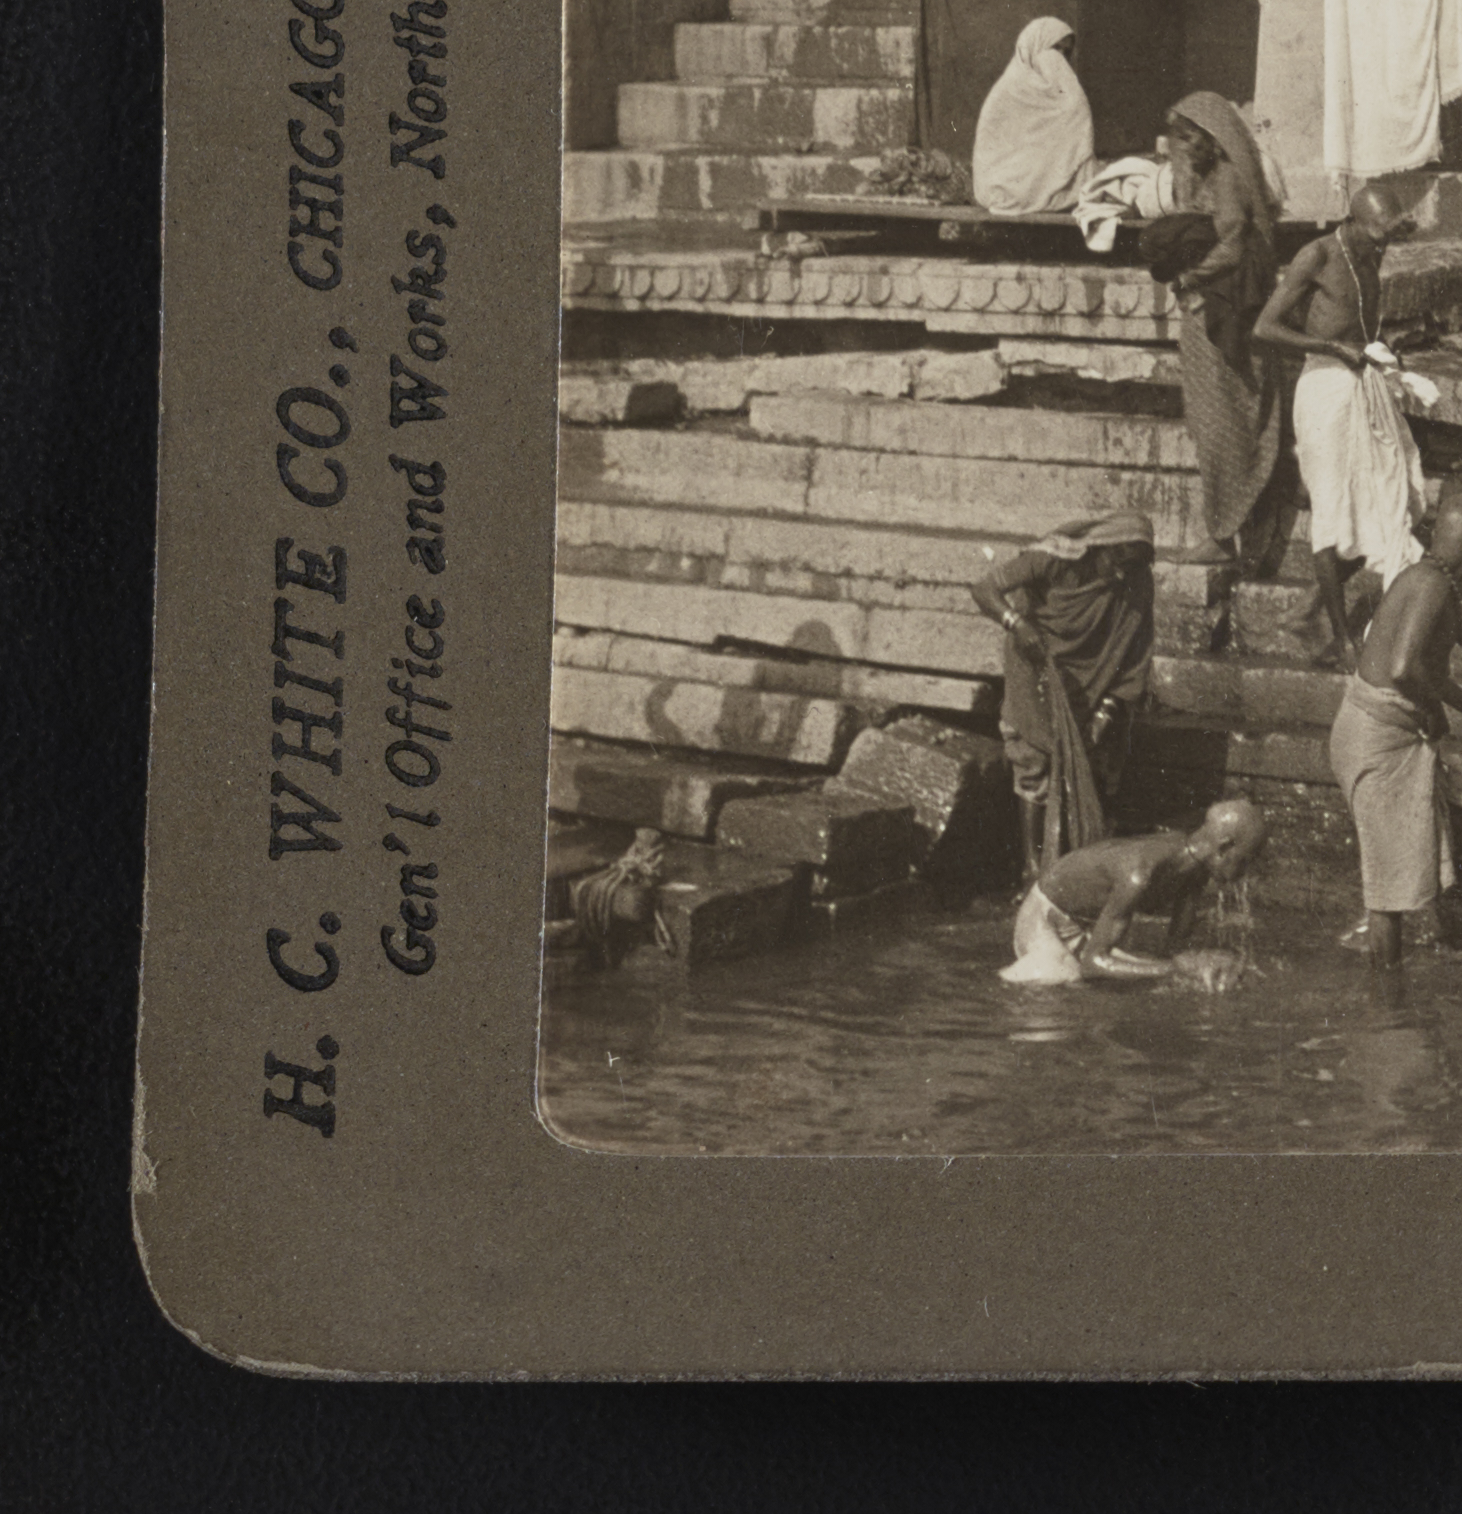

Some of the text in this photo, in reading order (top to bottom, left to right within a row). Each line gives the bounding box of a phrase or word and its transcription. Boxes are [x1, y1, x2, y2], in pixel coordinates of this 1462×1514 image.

[387, 0, 449, 181] North
[388, 203, 457, 429] Works,
[274, 326, 359, 508] CO.,
[388, 454, 446, 575] and
[267, 536, 347, 861] WHITE
[384, 594, 453, 788] Office
[265, 911, 342, 994] C.
[262, 1034, 340, 1139] H.
